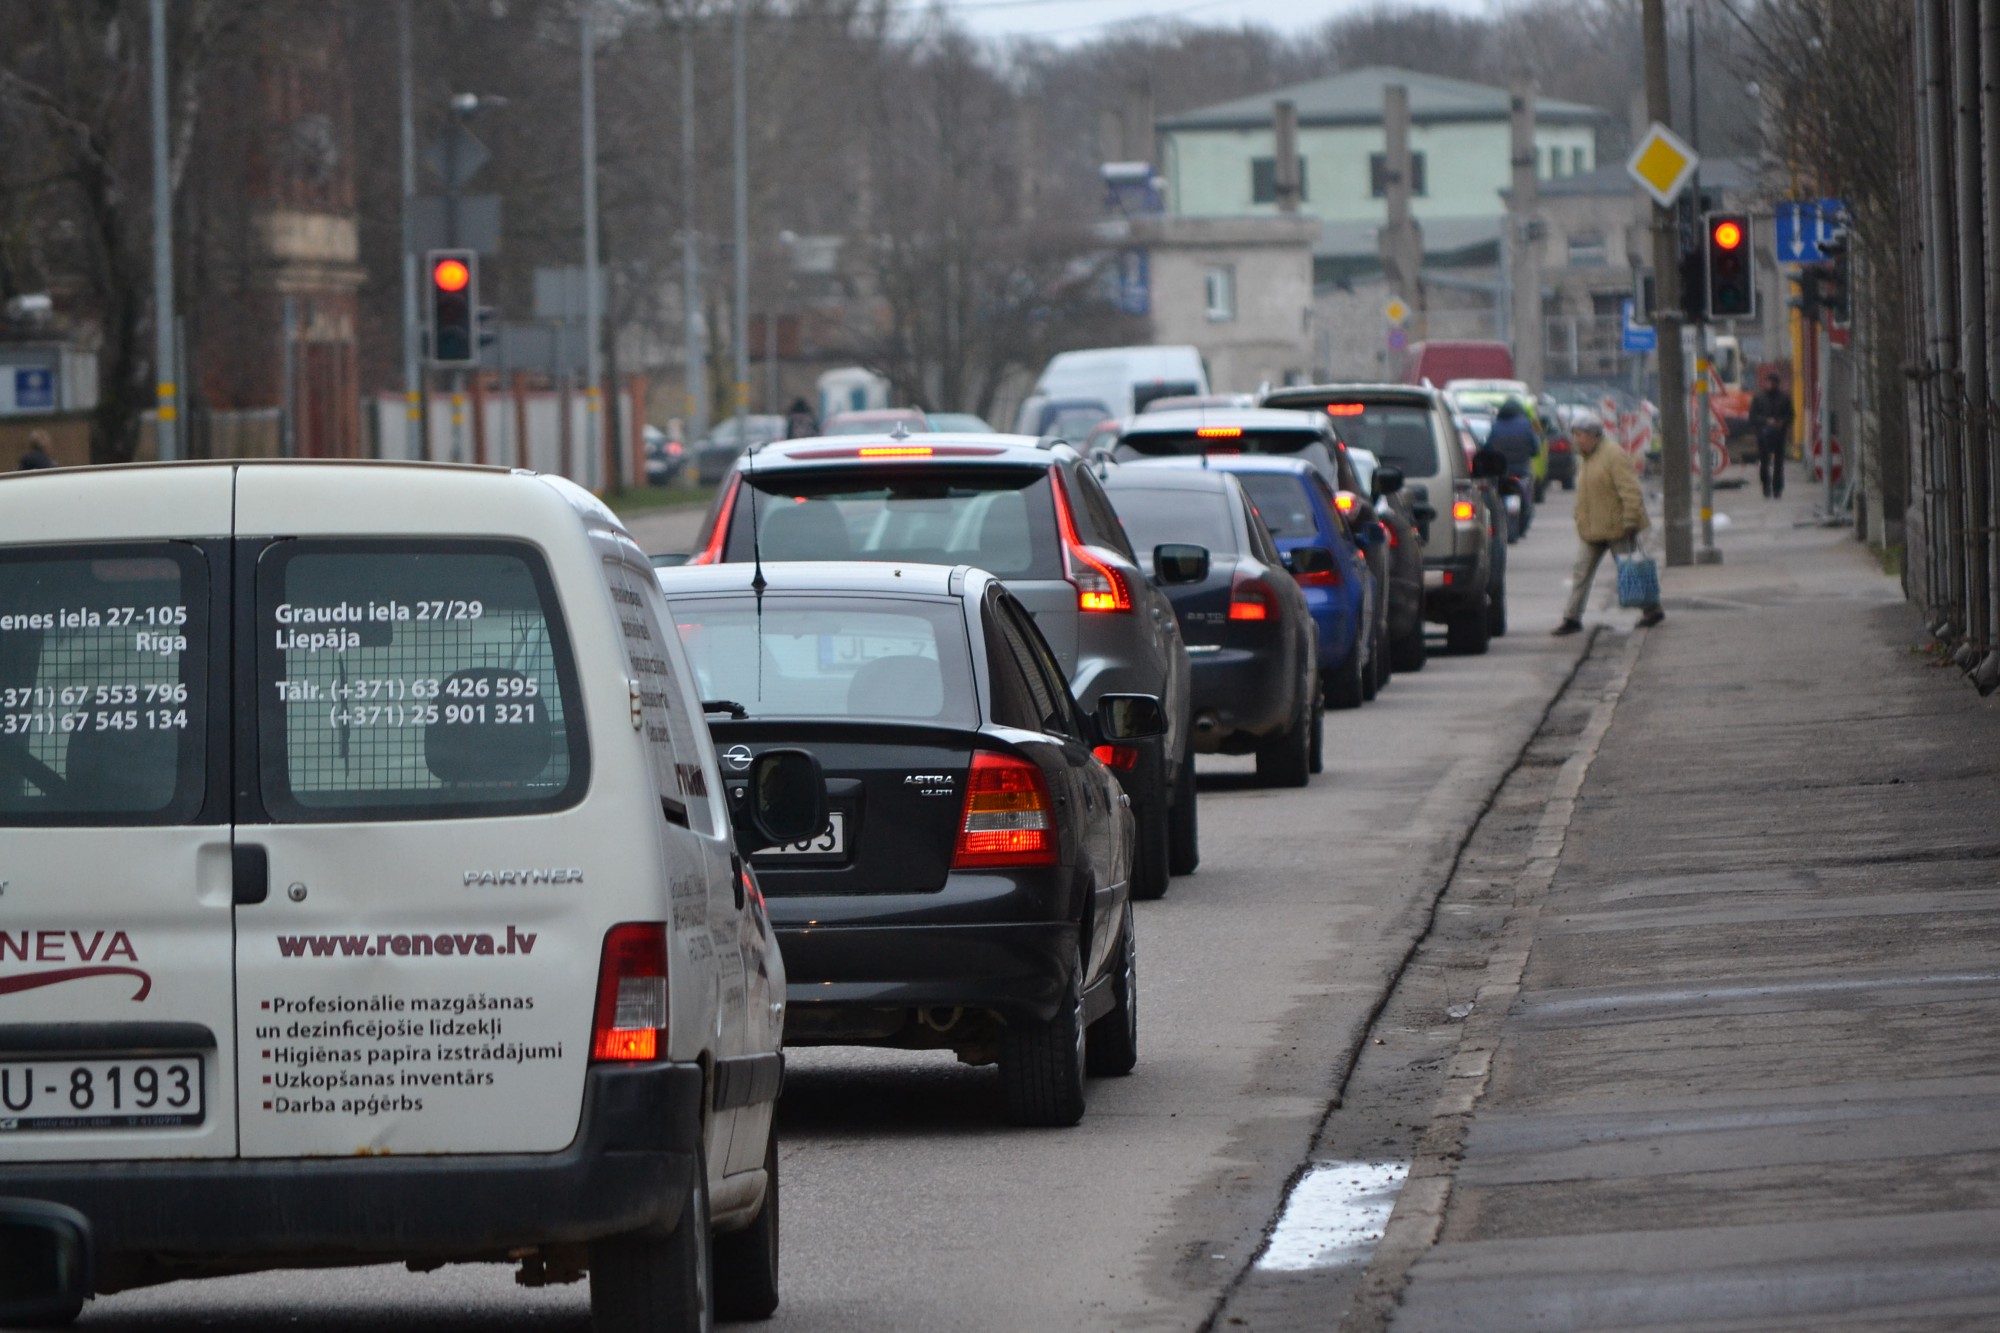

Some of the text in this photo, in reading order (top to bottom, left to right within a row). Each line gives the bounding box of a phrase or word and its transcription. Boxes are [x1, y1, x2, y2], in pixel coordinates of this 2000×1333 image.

[0, 606, 187, 631] enes iela 27-105
[275, 600, 483, 624] Graudu iela 27/29
[136, 632, 188, 656] Rīga
[275, 629, 361, 653] Liepāja
[0, 683, 188, 708] 371) 67 553 796
[275, 677, 538, 702] Tālr. (+371) 63 426 595
[61, 712, 89, 731] 67
[96, 710, 138, 730] 545
[146, 709, 188, 729] 134
[330, 703, 536, 728] (+371) 25 901 321
[903, 775, 955, 785] ASTRA
[463, 867, 584, 887] PARTNER
[0, 930, 139, 962] NEVA
[277, 925, 538, 958] www.reneva.lv
[273, 993, 534, 1015] Profesionālie mazgāšanas
[256, 1017, 502, 1041] un dezinficējošie līdzekļi
[274, 1042, 562, 1068] Higiēnas papīra izstrādājumi
[2, 1065, 191, 1112] U-8193
[275, 1067, 494, 1090] Uzkopšanas inventārs
[275, 1093, 423, 1115] Darba apģērbs
